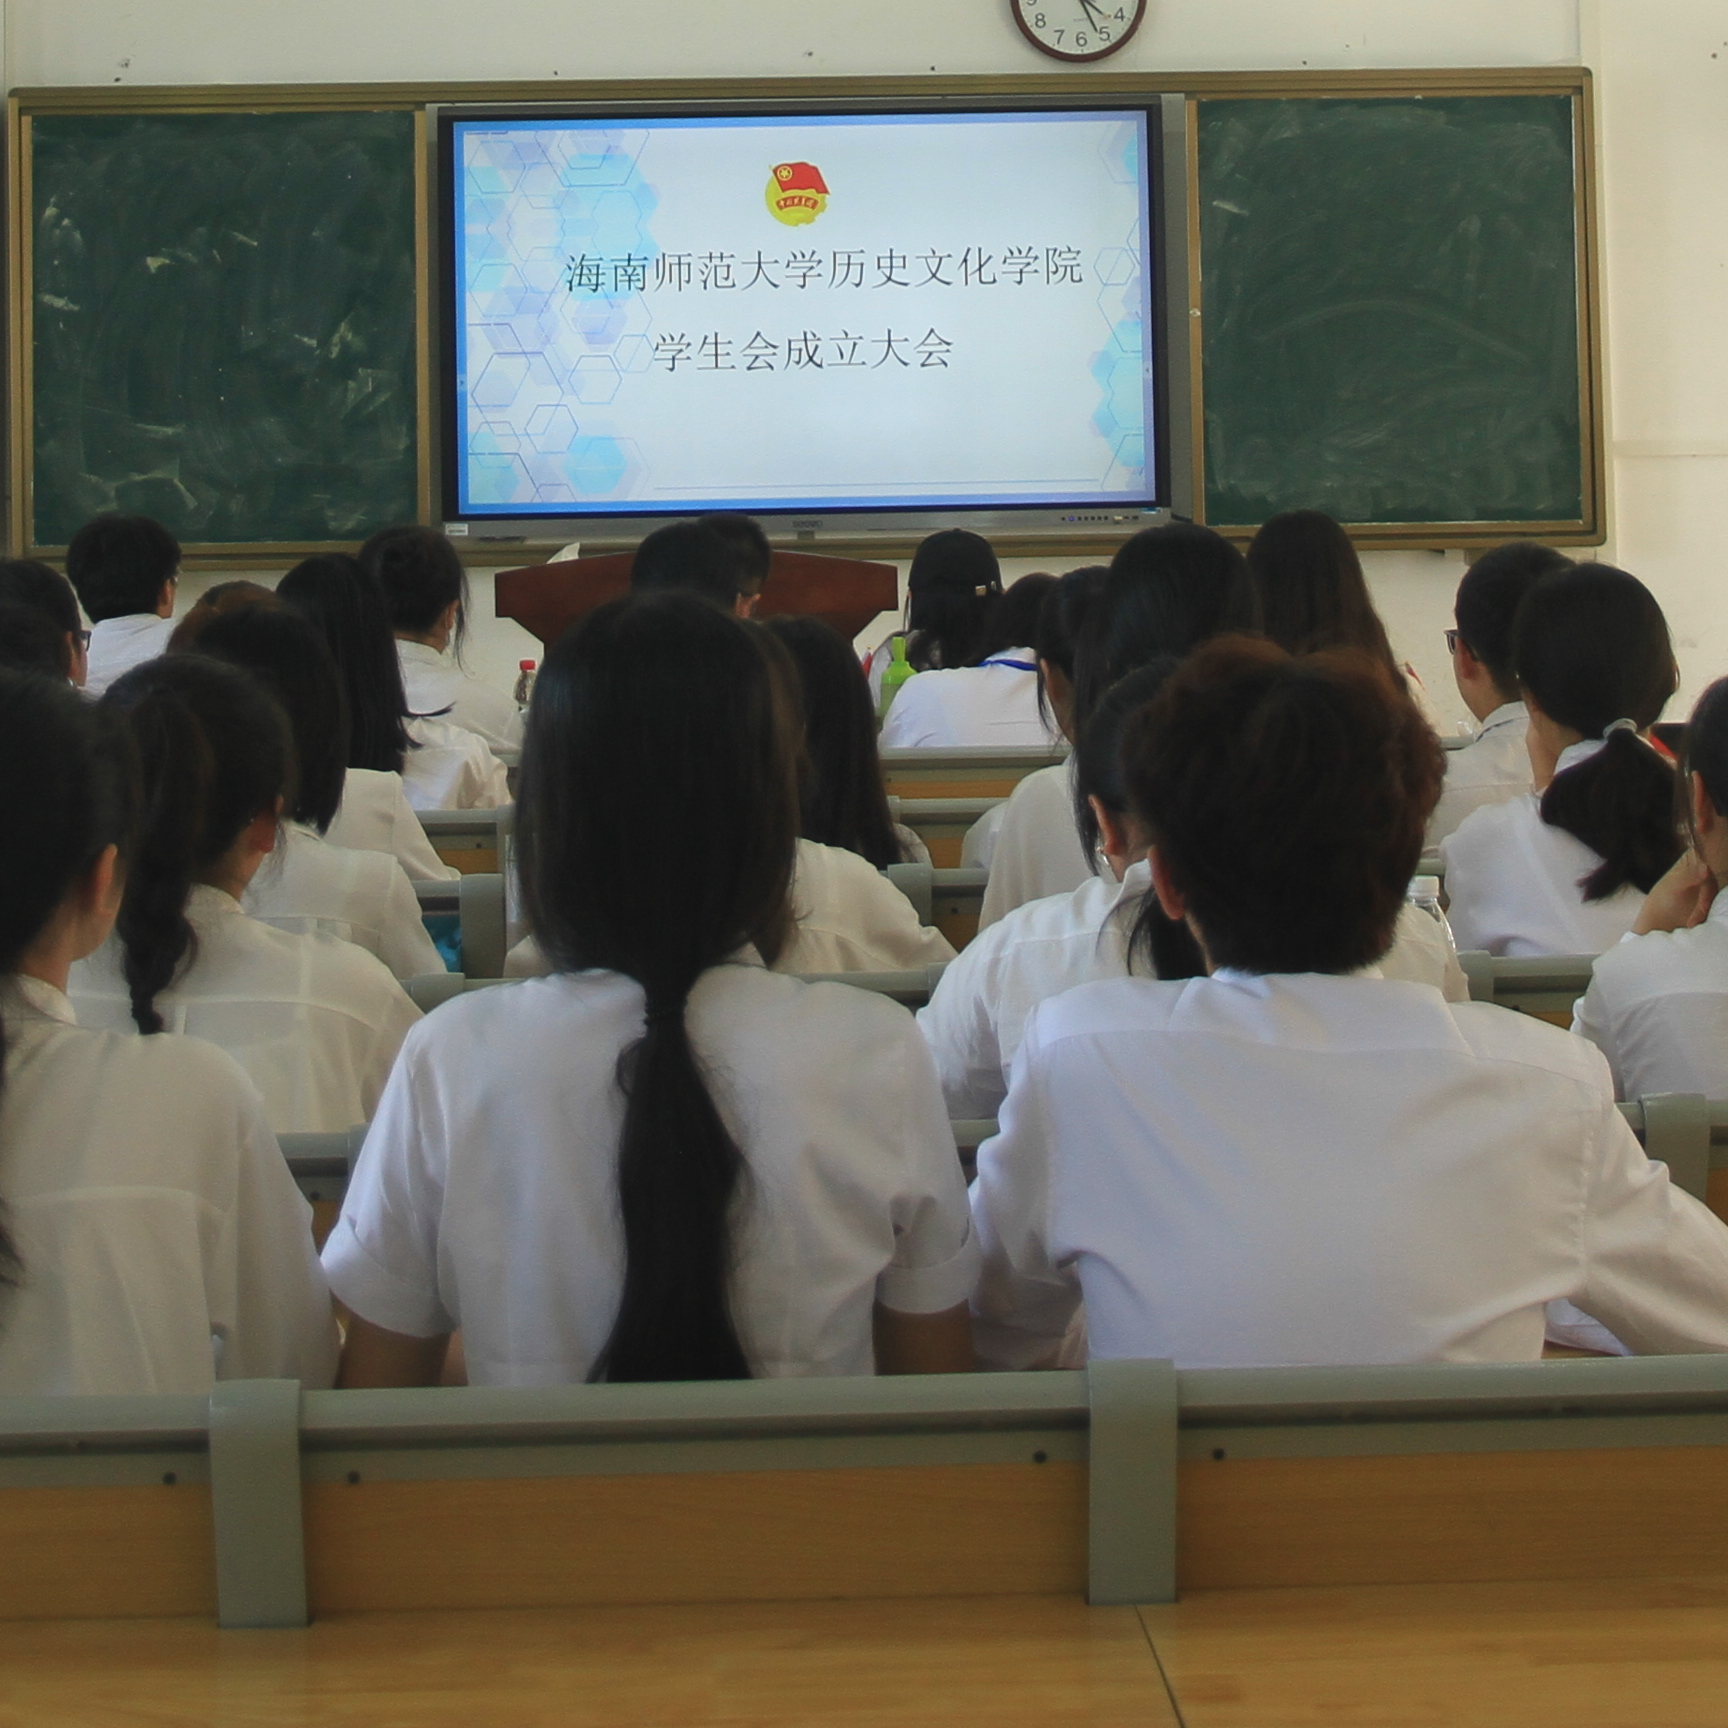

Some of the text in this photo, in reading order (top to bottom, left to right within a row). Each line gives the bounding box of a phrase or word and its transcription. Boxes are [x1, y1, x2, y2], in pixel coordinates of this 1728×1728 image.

[1034, 12, 1047, 29] 8
[1113, 6, 1126, 22] 4
[1053, 29, 1065, 45] 7
[1075, 31, 1088, 47] 6
[1098, 25, 1111, 42] 5
[565, 245, 1084, 294] 海南师范大学历史文化学院
[654, 327, 953, 373] 学生会成立大会
